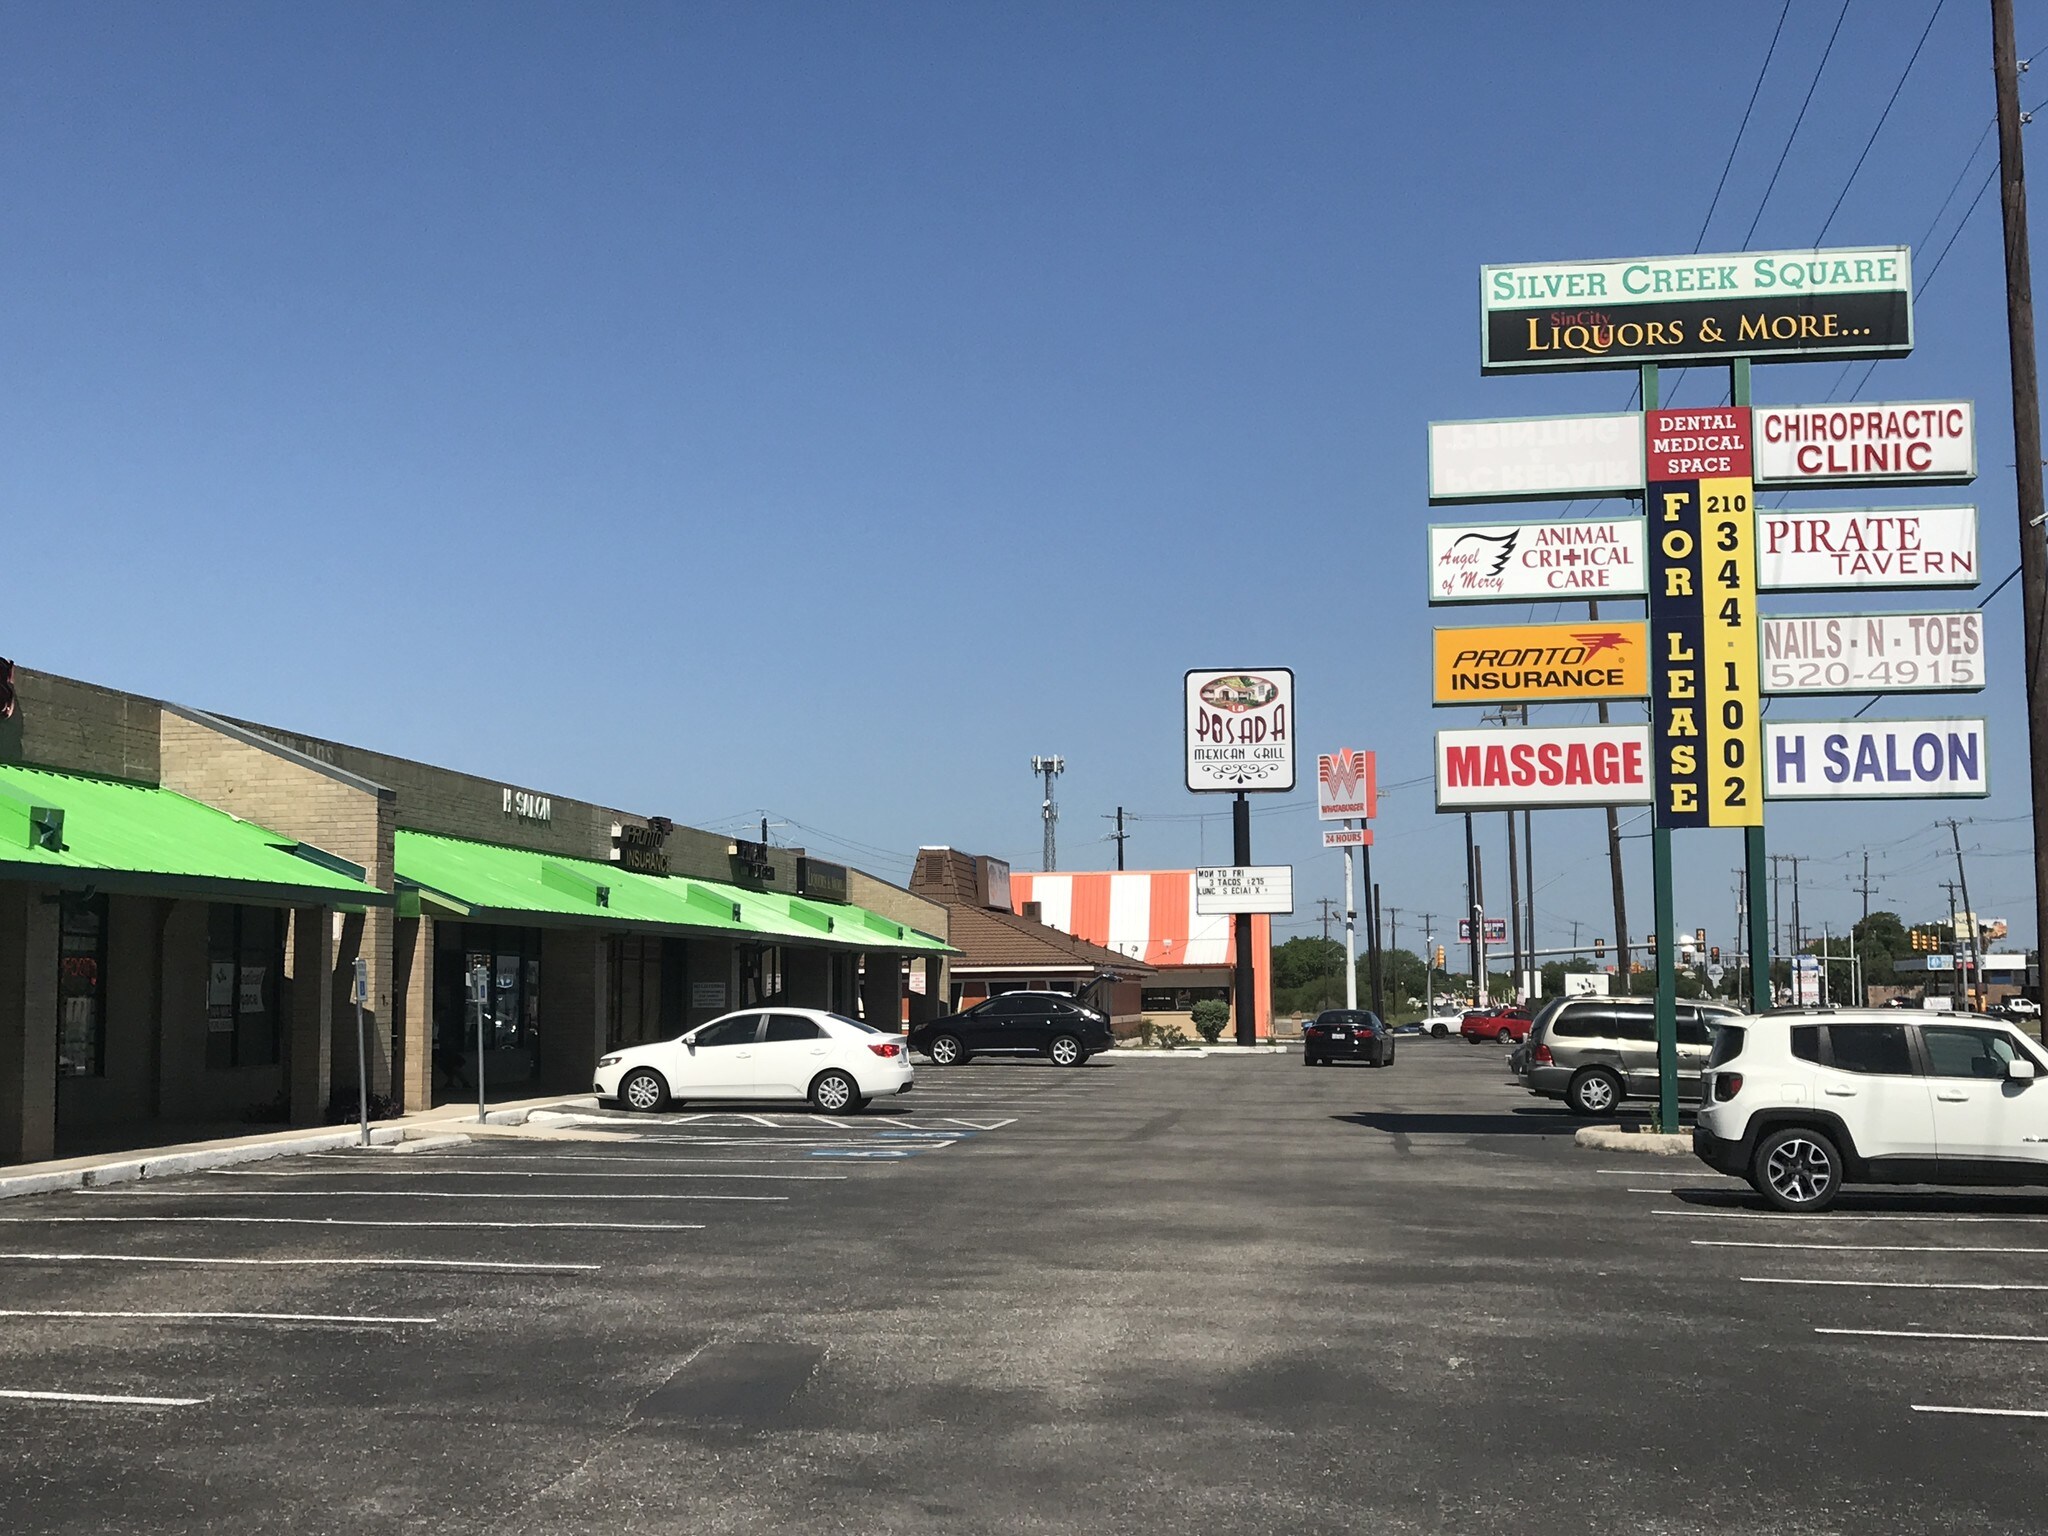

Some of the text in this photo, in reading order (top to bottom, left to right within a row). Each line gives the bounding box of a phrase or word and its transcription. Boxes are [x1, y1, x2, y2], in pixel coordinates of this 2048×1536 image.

[1493, 258, 1897, 300] SILVER CREEK SQUARE
[1526, 317, 1684, 354] LIQUORS
[1699, 317, 1726, 343] &
[1659, 414, 1736, 432] DENTAL
[1765, 408, 1964, 443] CHIROPRACTIC
[1653, 435, 1744, 454] MEDICAL
[1667, 457, 1731, 474] SPACE
[1796, 442, 1932, 474] CLINIC
[1707, 495, 1746, 513] 210
[1535, 525, 1619, 546] ANIMAL
[1765, 517, 1922, 554] PIRATE
[1438, 547, 1480, 570] Angel
[1830, 551, 1972, 576] TAVERN
[1442, 571, 1504, 595] of Mercy
[1547, 569, 1610, 589] CARE
[1764, 619, 1842, 660] NAILS
[1909, 615, 1979, 656] TOES
[1452, 647, 1587, 669] PRONTO
[1452, 669, 1624, 690] INSURANCE
[1771, 660, 1974, 688] 520-4915
[1195, 703, 1286, 744] POSADA
[1194, 747, 1285, 760] MEXICAN GRILL
[1446, 742, 1643, 787] MASSAGE
[1776, 732, 1979, 784] H SALON
[516, 791, 551, 821] SALON
[1322, 803, 1364, 813] WHATABURGER
[1325, 833, 1361, 843] 24 HOURS
[1218, 878, 1241, 886] TACOS
